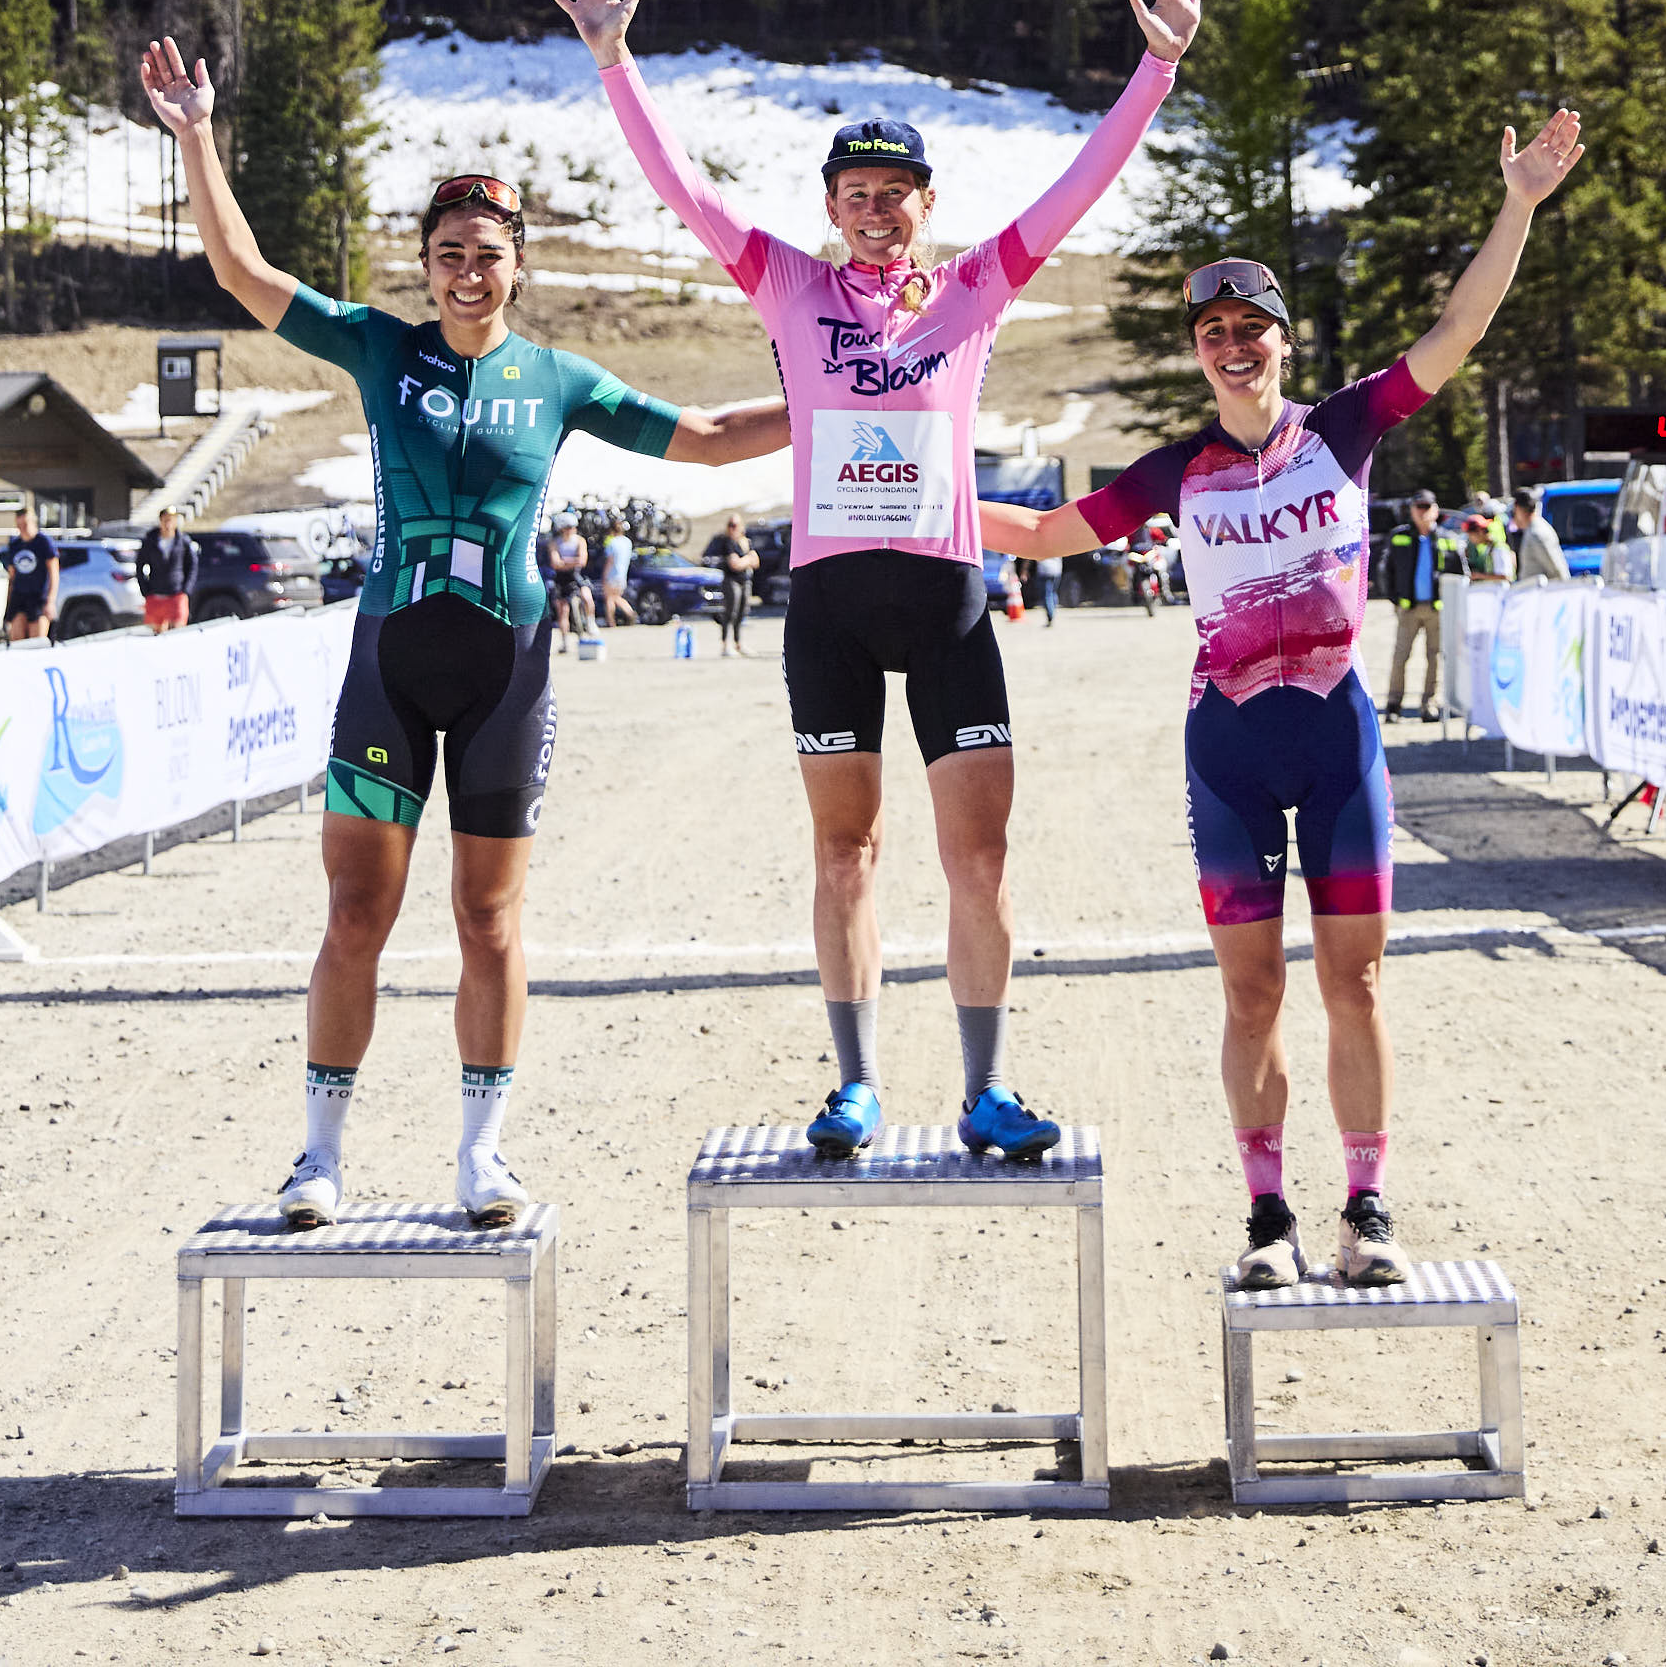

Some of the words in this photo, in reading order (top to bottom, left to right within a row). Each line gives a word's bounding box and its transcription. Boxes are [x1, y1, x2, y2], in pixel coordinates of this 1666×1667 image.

[847, 140, 873, 153] The
[817, 316, 882, 360] Tour
[419, 349, 456, 373] wahoo
[822, 358, 843, 374] De
[845, 350, 949, 396] Bloom
[417, 415, 463, 435] CYCLIN
[476, 426, 515, 436] GUILD
[837, 463, 919, 483] AEGIS
[371, 423, 386, 574] cannondale
[870, 486, 918, 494] FOUNDATION
[1193, 489, 1340, 548] VALKYR
